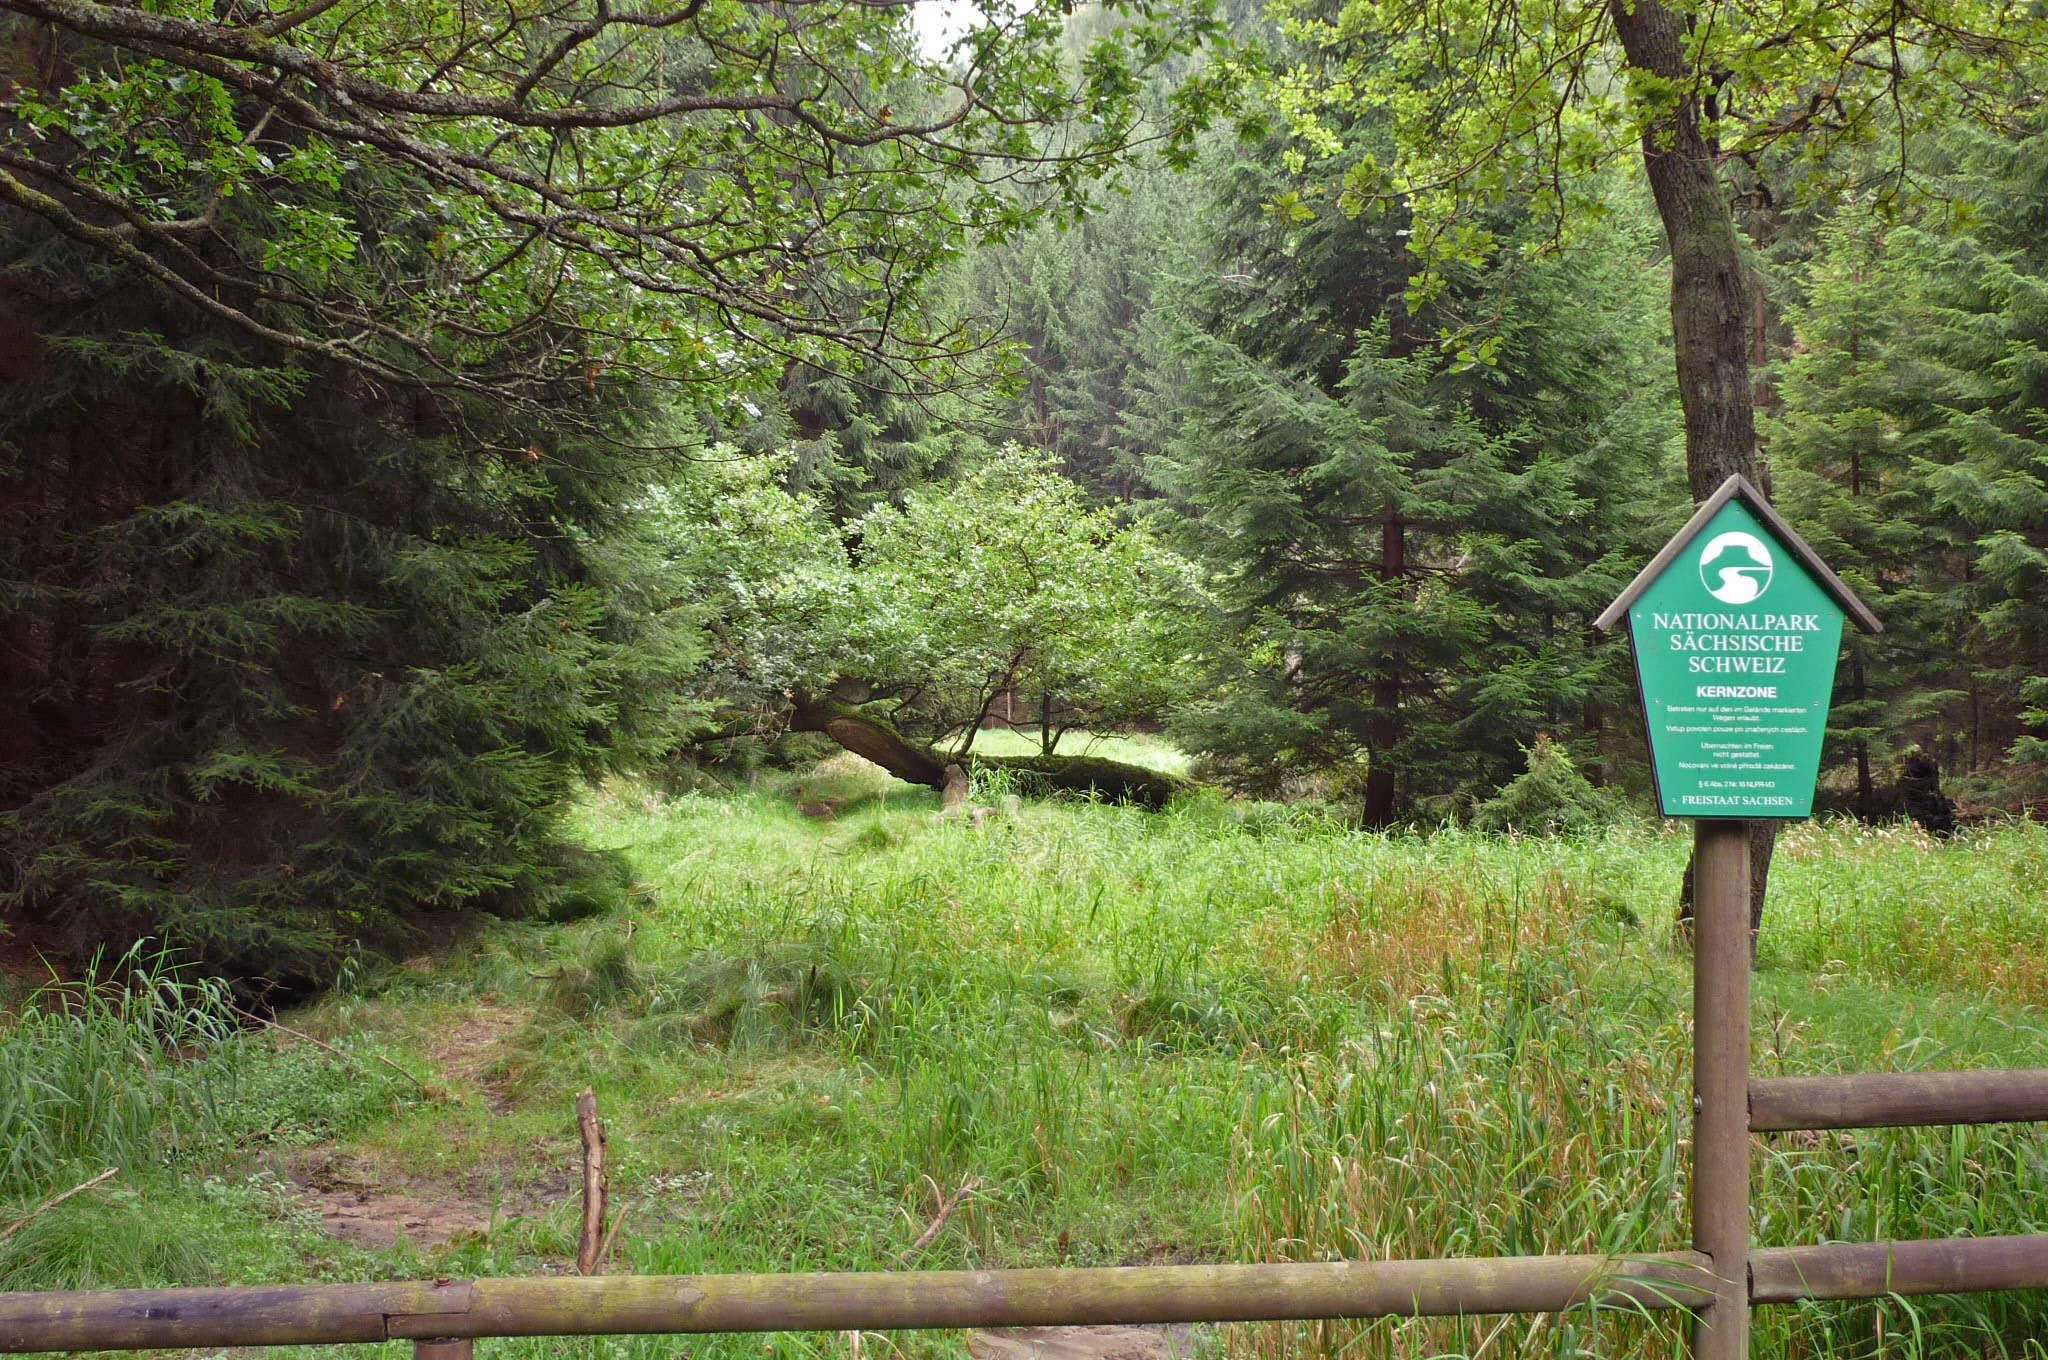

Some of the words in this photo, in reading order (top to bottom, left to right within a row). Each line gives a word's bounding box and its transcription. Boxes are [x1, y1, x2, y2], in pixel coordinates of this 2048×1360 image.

[1652, 613, 1820, 631] NATIONALPARK
[1670, 631, 1803, 652] SÄCHSISCHE
[1688, 656, 1786, 674] SCHWEIZ
[1696, 685, 1777, 698] KERNZONE
[1712, 713, 1736, 722] Wegen
[1682, 794, 1740, 805] FREISTAAT
[1742, 795, 1793, 806] SACHSEN
